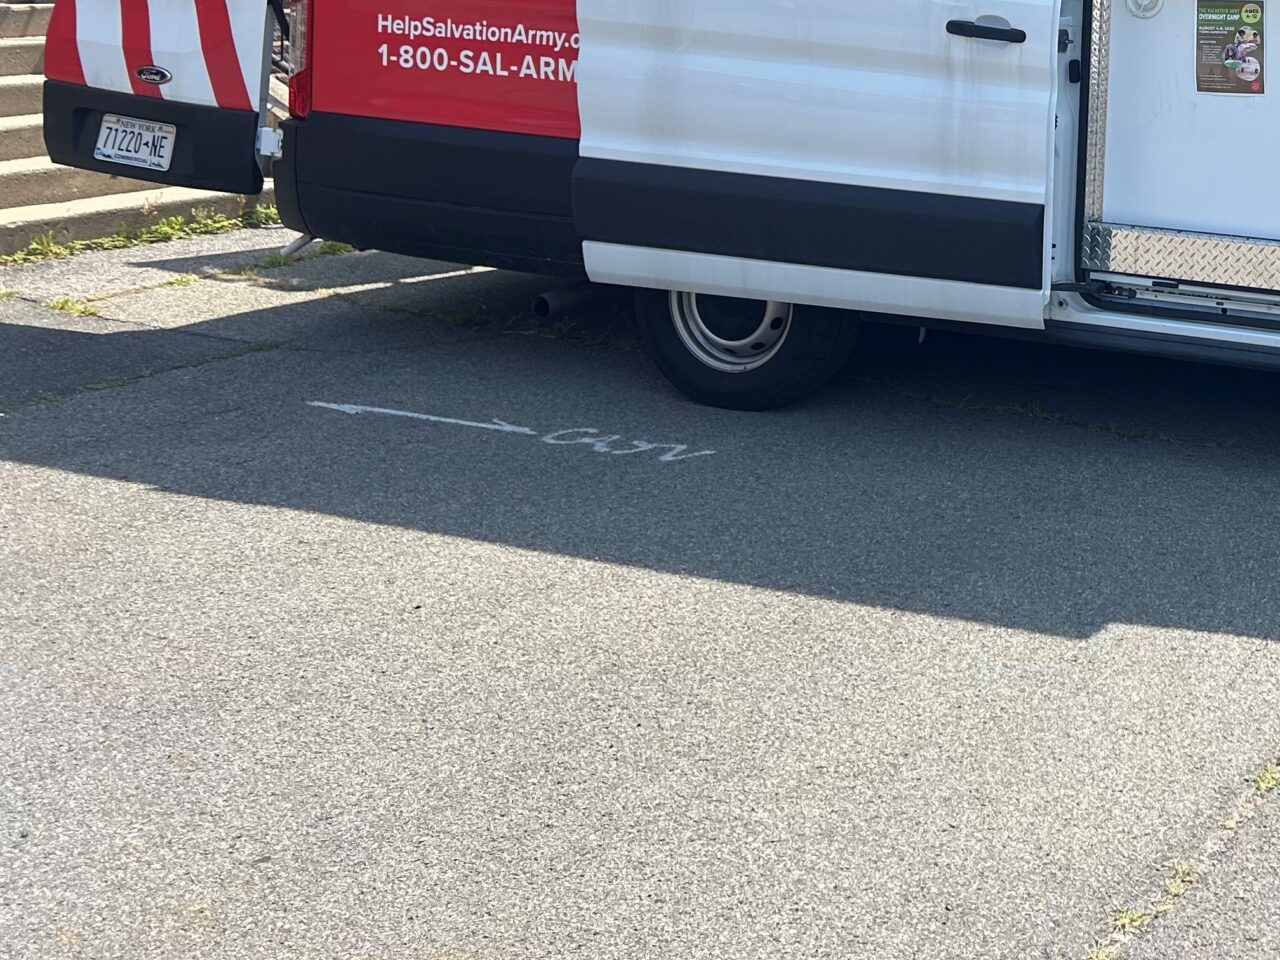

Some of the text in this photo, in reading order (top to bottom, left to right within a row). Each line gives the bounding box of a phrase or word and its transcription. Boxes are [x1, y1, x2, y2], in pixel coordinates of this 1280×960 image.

[120, 121, 157, 133] NEW YORK
[103, 126, 168, 159] 71220 NE
